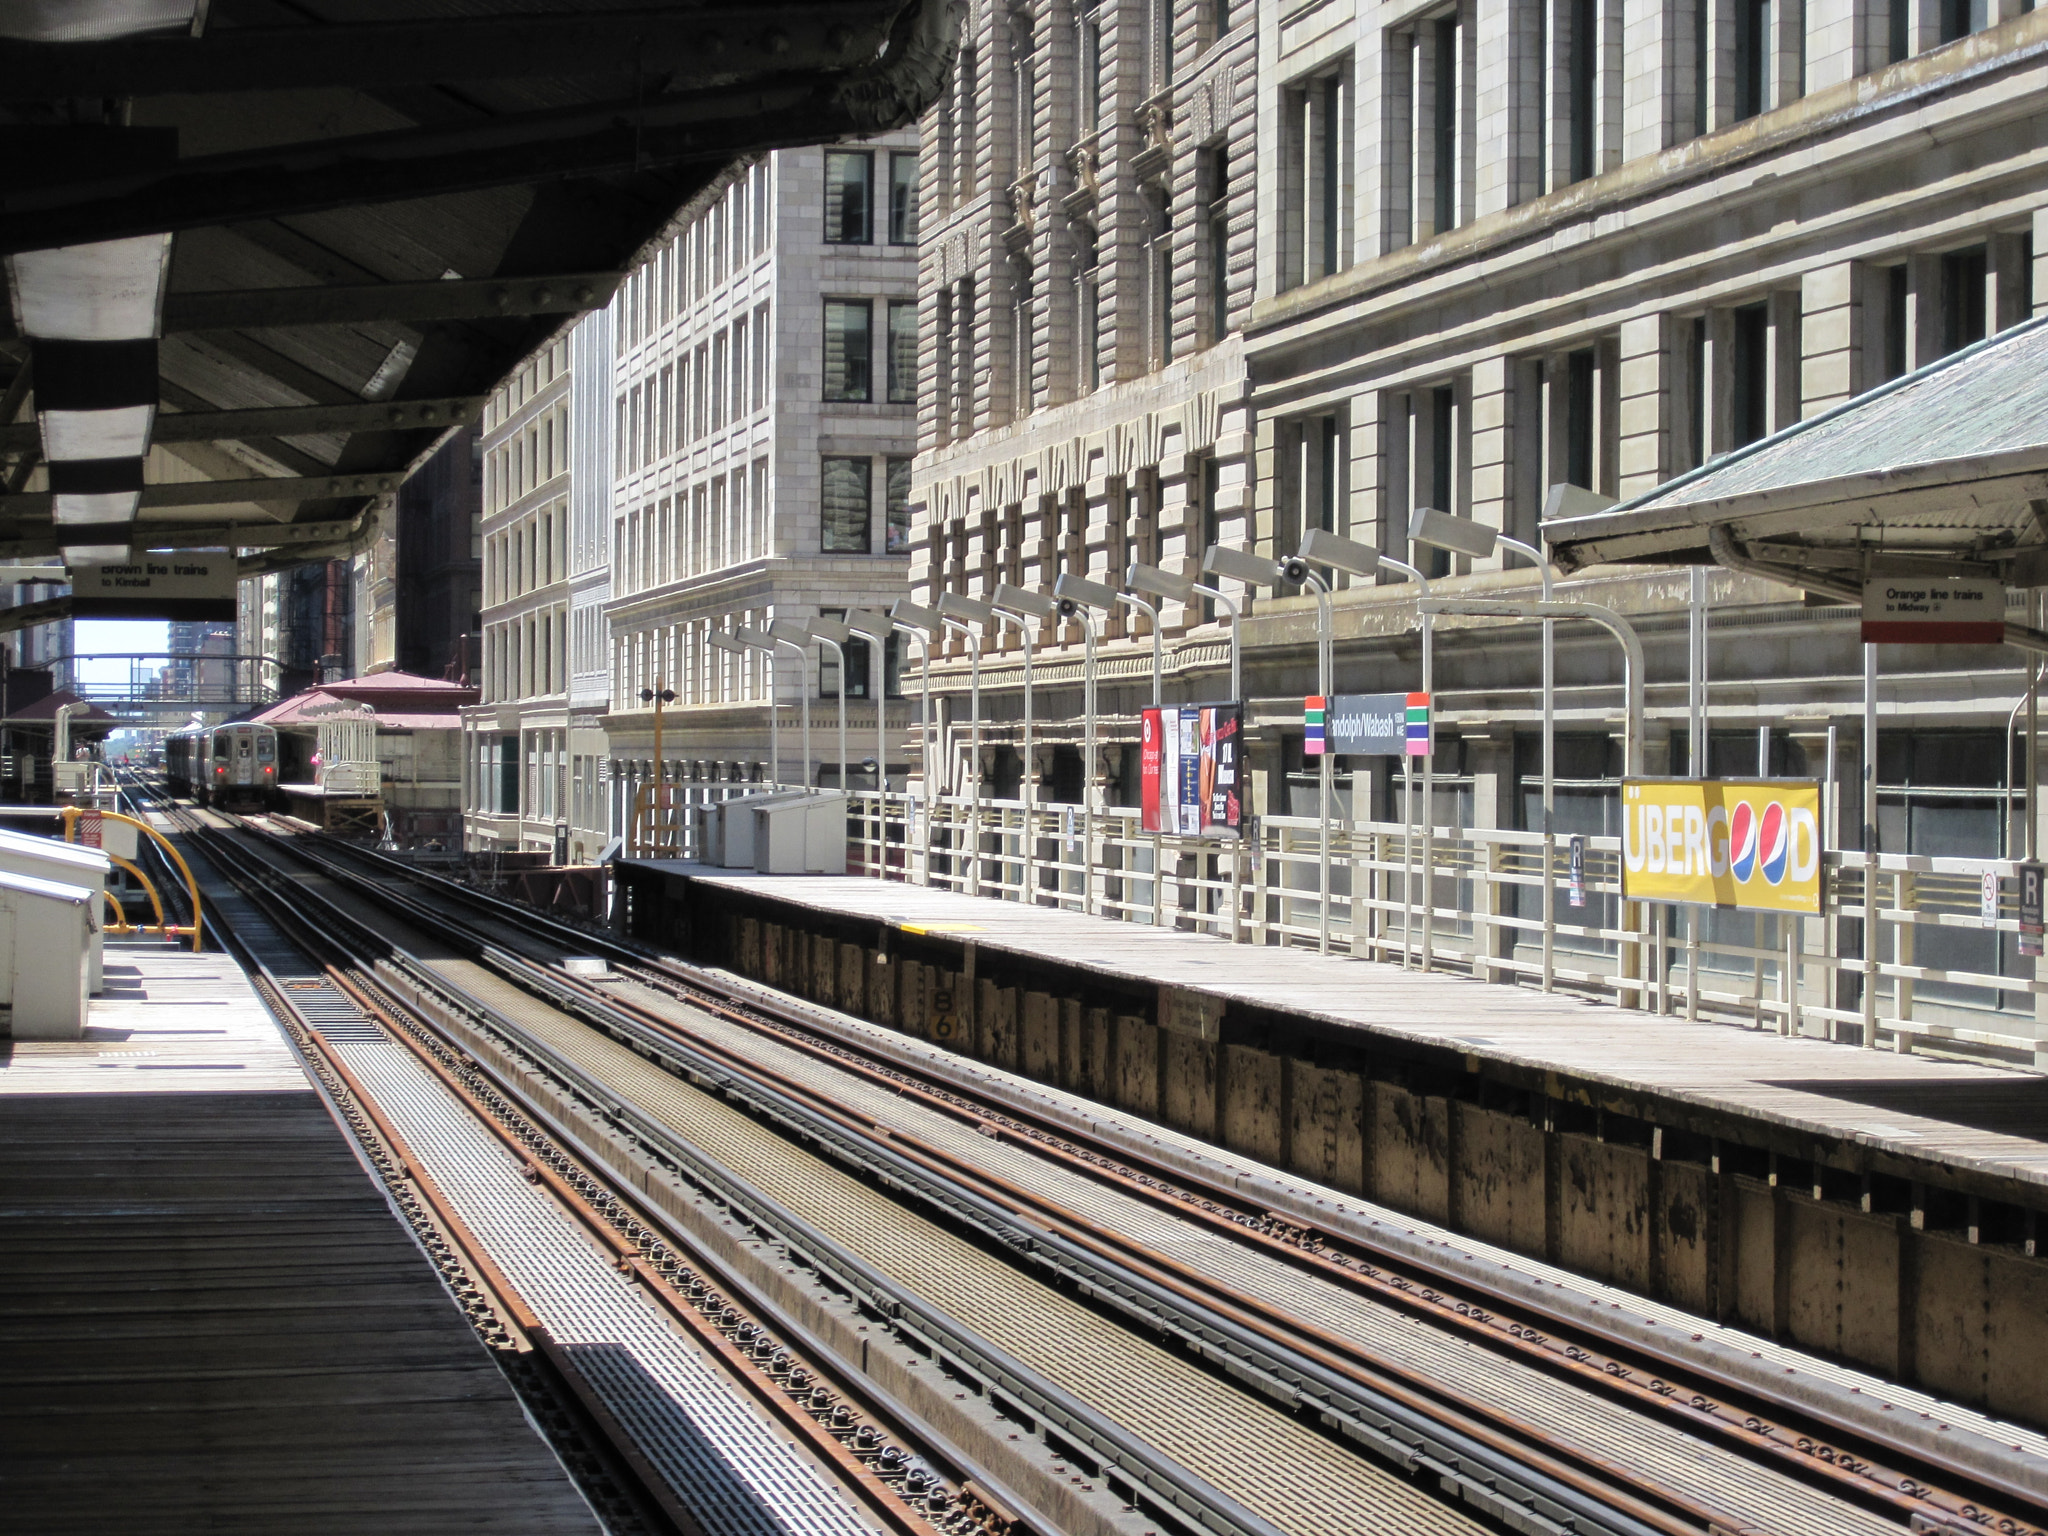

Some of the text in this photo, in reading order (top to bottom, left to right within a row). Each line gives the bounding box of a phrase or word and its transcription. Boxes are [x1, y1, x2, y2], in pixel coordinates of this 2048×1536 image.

[147, 563, 168, 575] line
[174, 563, 208, 576] trains
[101, 577, 151, 587] to Kimball
[1886, 588, 1983, 601] Orange line trains
[1886, 603, 1930, 613] to Midway
[1573, 841, 1581, 868] R
[2025, 871, 2038, 906] R
[936, 1015, 952, 1037] 6
